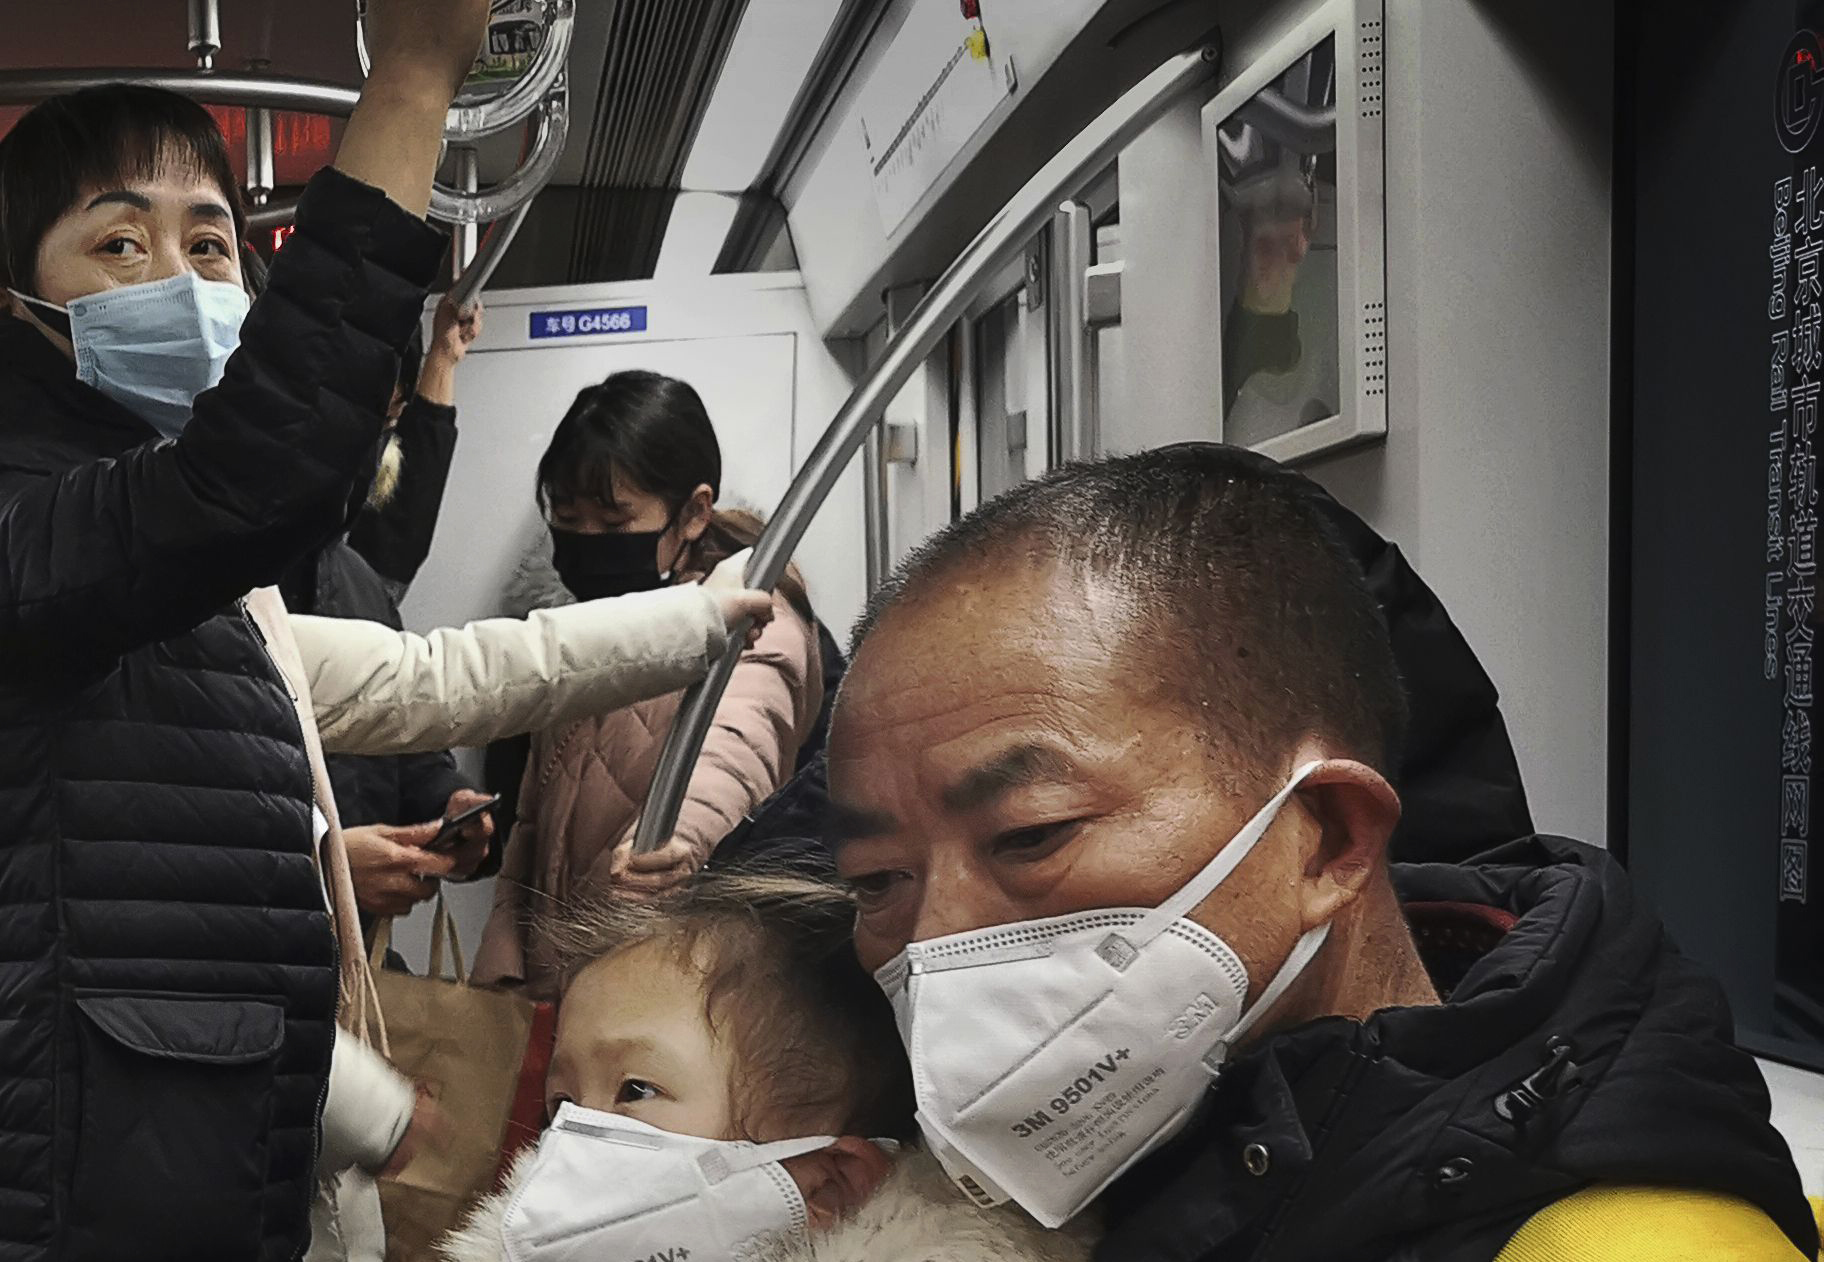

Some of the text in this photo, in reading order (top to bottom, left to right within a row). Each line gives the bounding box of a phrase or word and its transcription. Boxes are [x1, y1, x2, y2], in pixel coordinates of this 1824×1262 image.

[1764, 176, 1792, 680] Beijing Rail Transit Lines
[1011, 1110, 1055, 1138] 3M
[1049, 1047, 1130, 1115] 9501V+
